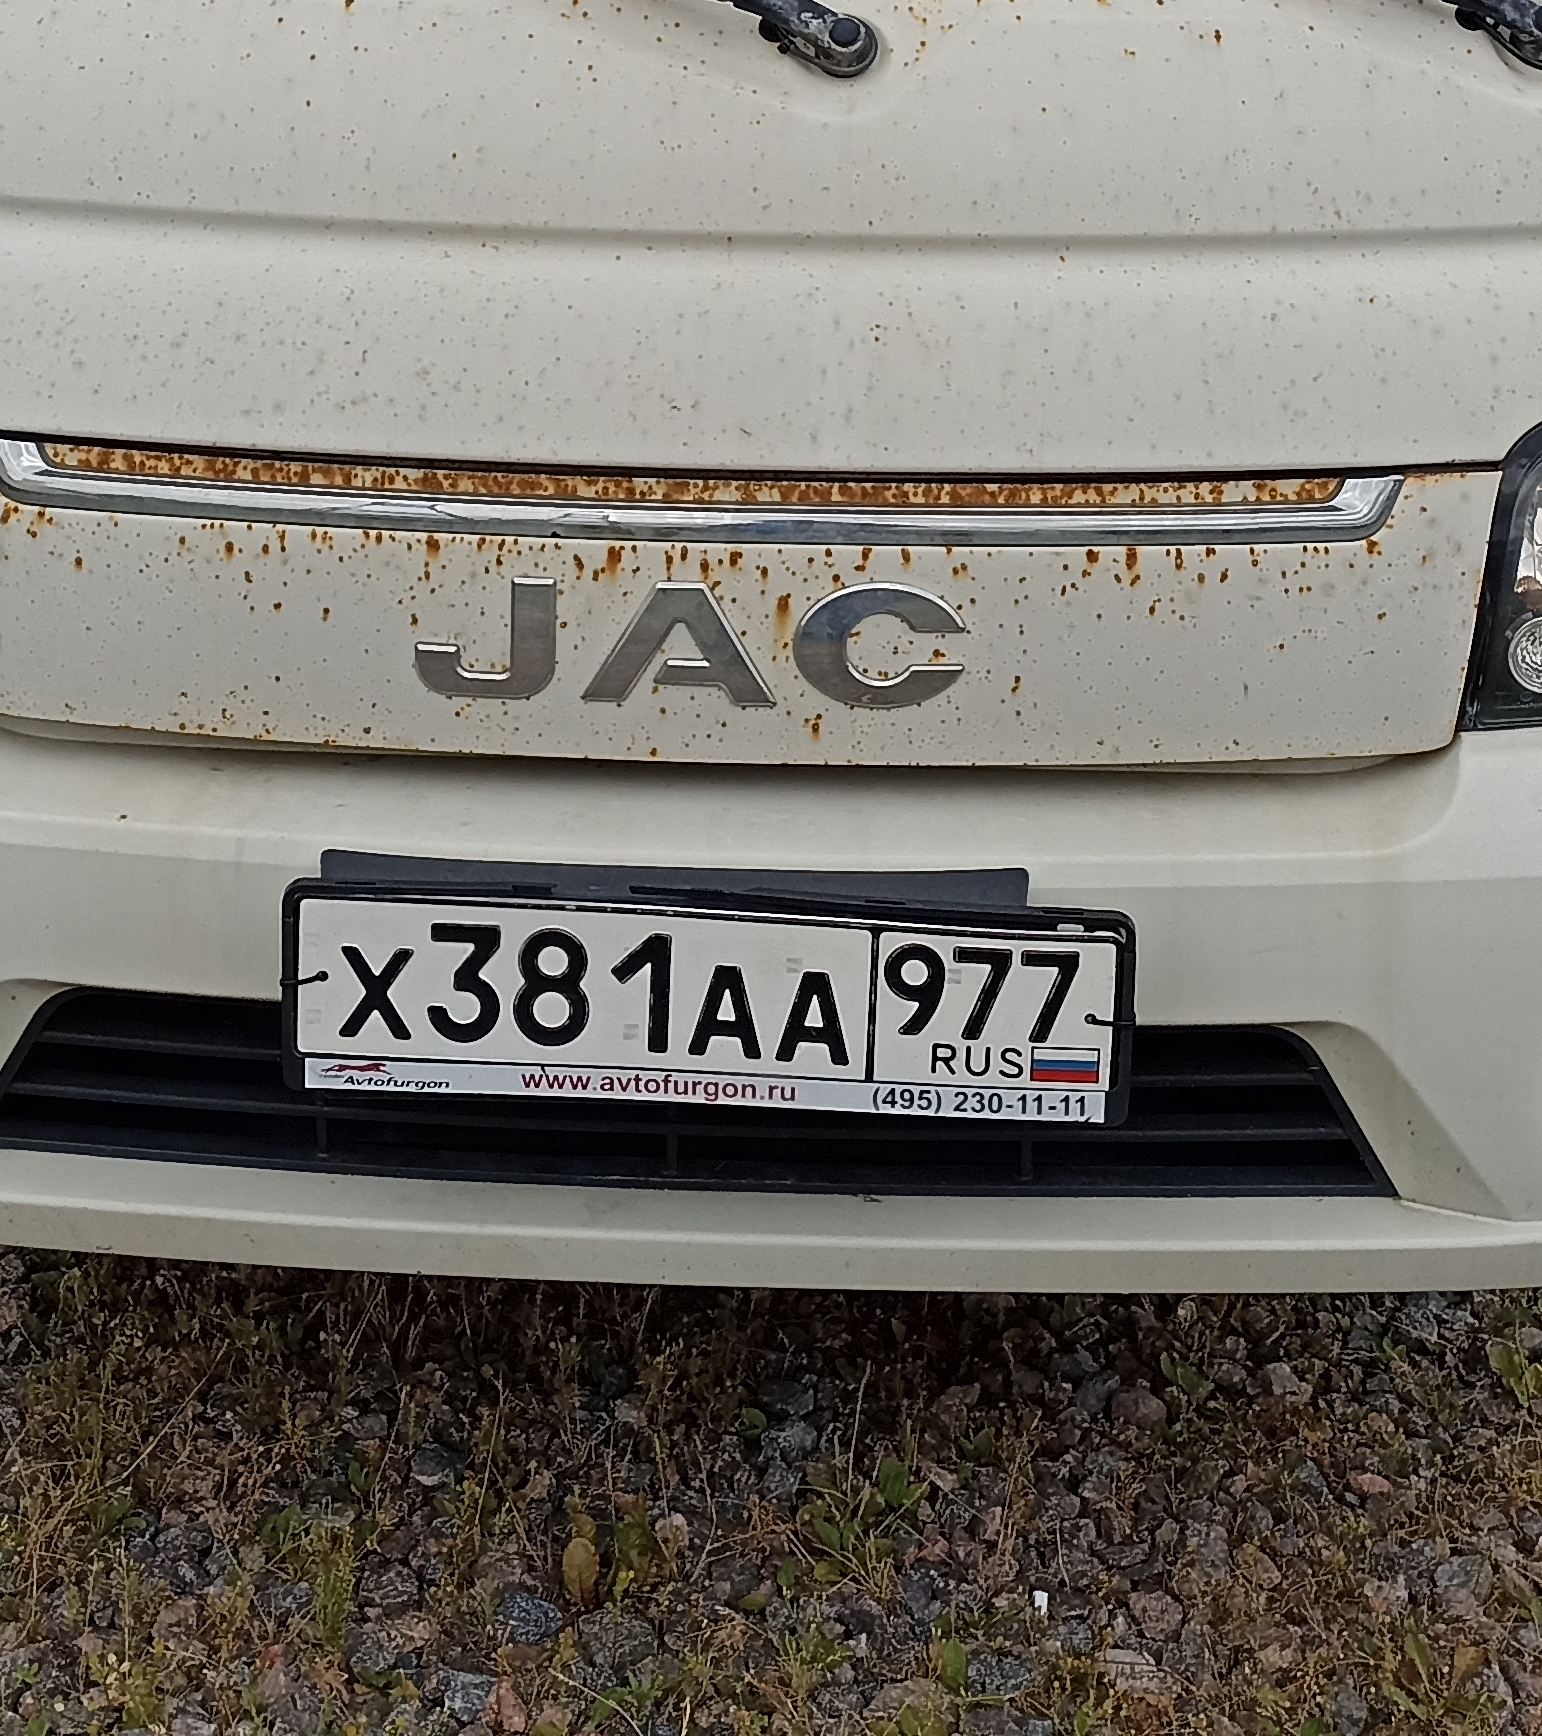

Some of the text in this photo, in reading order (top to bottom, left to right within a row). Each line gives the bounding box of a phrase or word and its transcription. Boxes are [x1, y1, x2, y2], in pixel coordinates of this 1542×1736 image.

[414, 576, 966, 709] JAC
[338, 923, 1081, 1066] Х381АА 977
[930, 1042, 1024, 1079] RUS
[343, 1075, 450, 1091] Avtofurgon
[521, 1073, 796, 1102] www.avtofurgon.ru
[872, 1086, 1087, 1117] (495) 230-11-11
